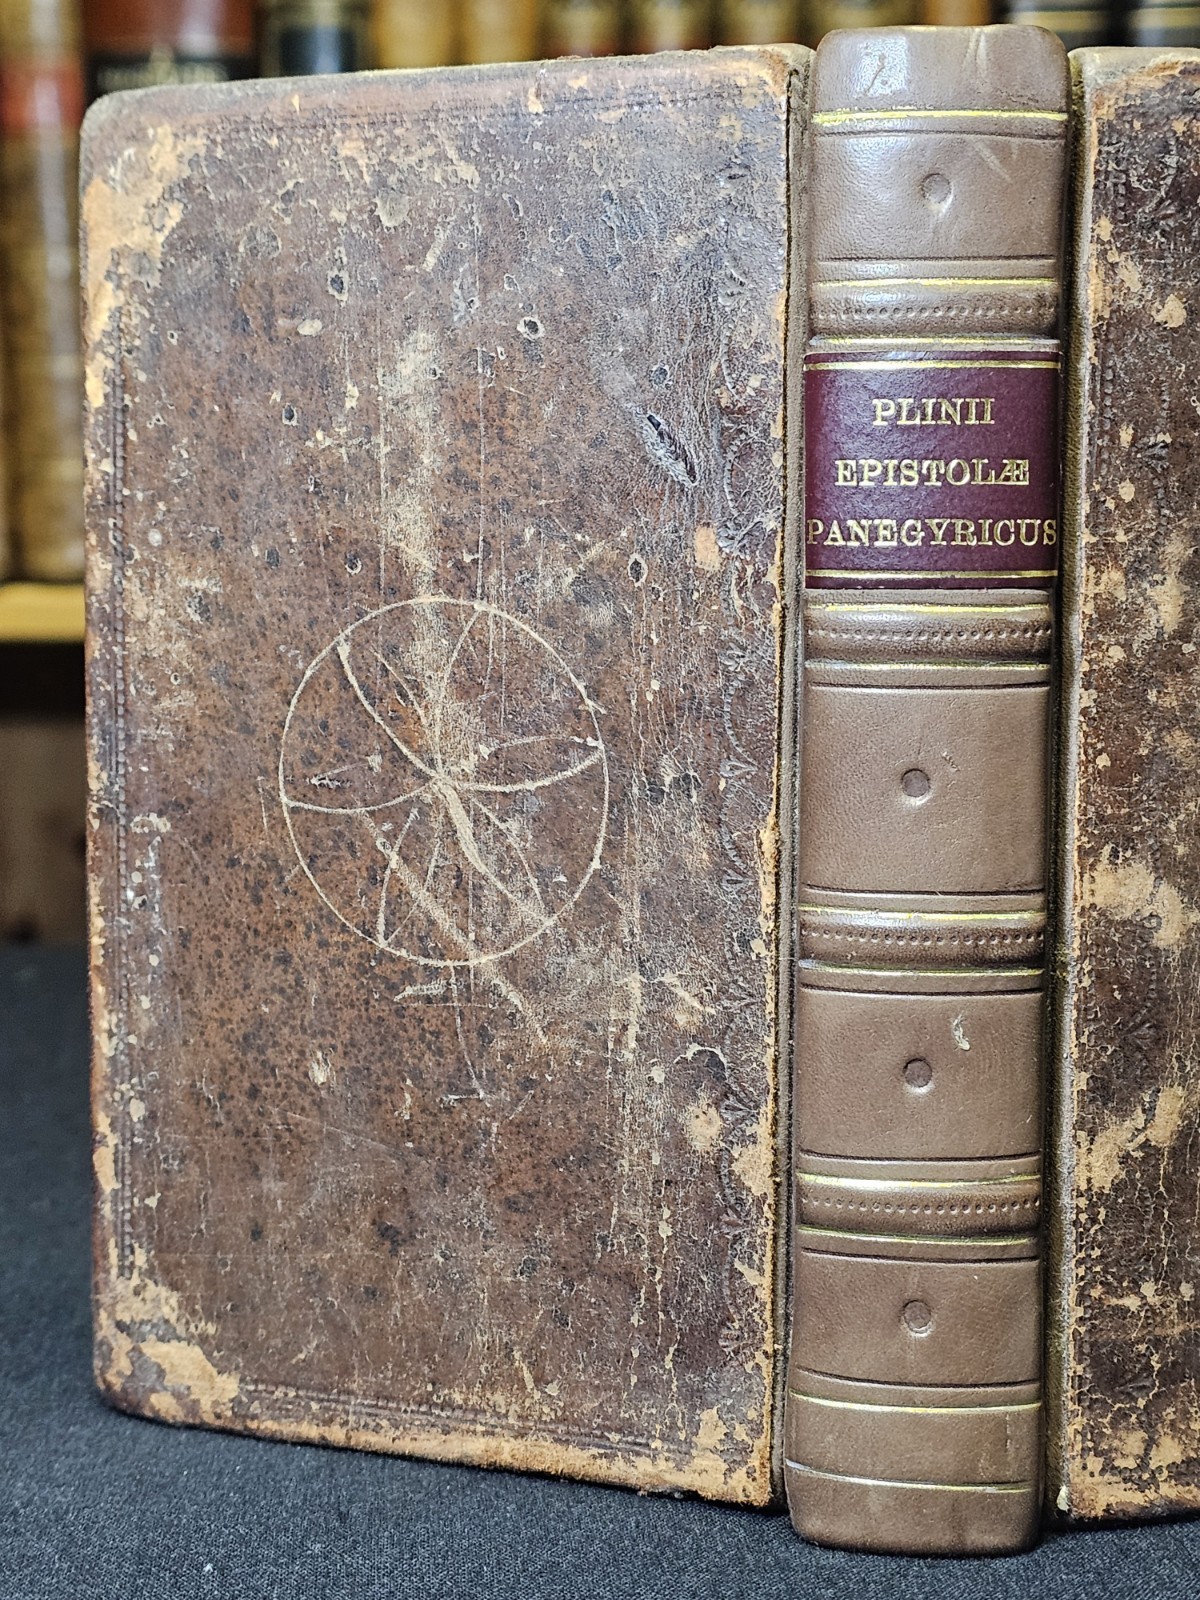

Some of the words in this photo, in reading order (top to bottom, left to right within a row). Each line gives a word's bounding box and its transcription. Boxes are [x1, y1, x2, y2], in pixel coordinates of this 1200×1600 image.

[872, 398, 995, 426] PLINII
[835, 458, 1029, 486] EPISTOLÆ
[806, 518, 1057, 547] PANEGYRICUS
